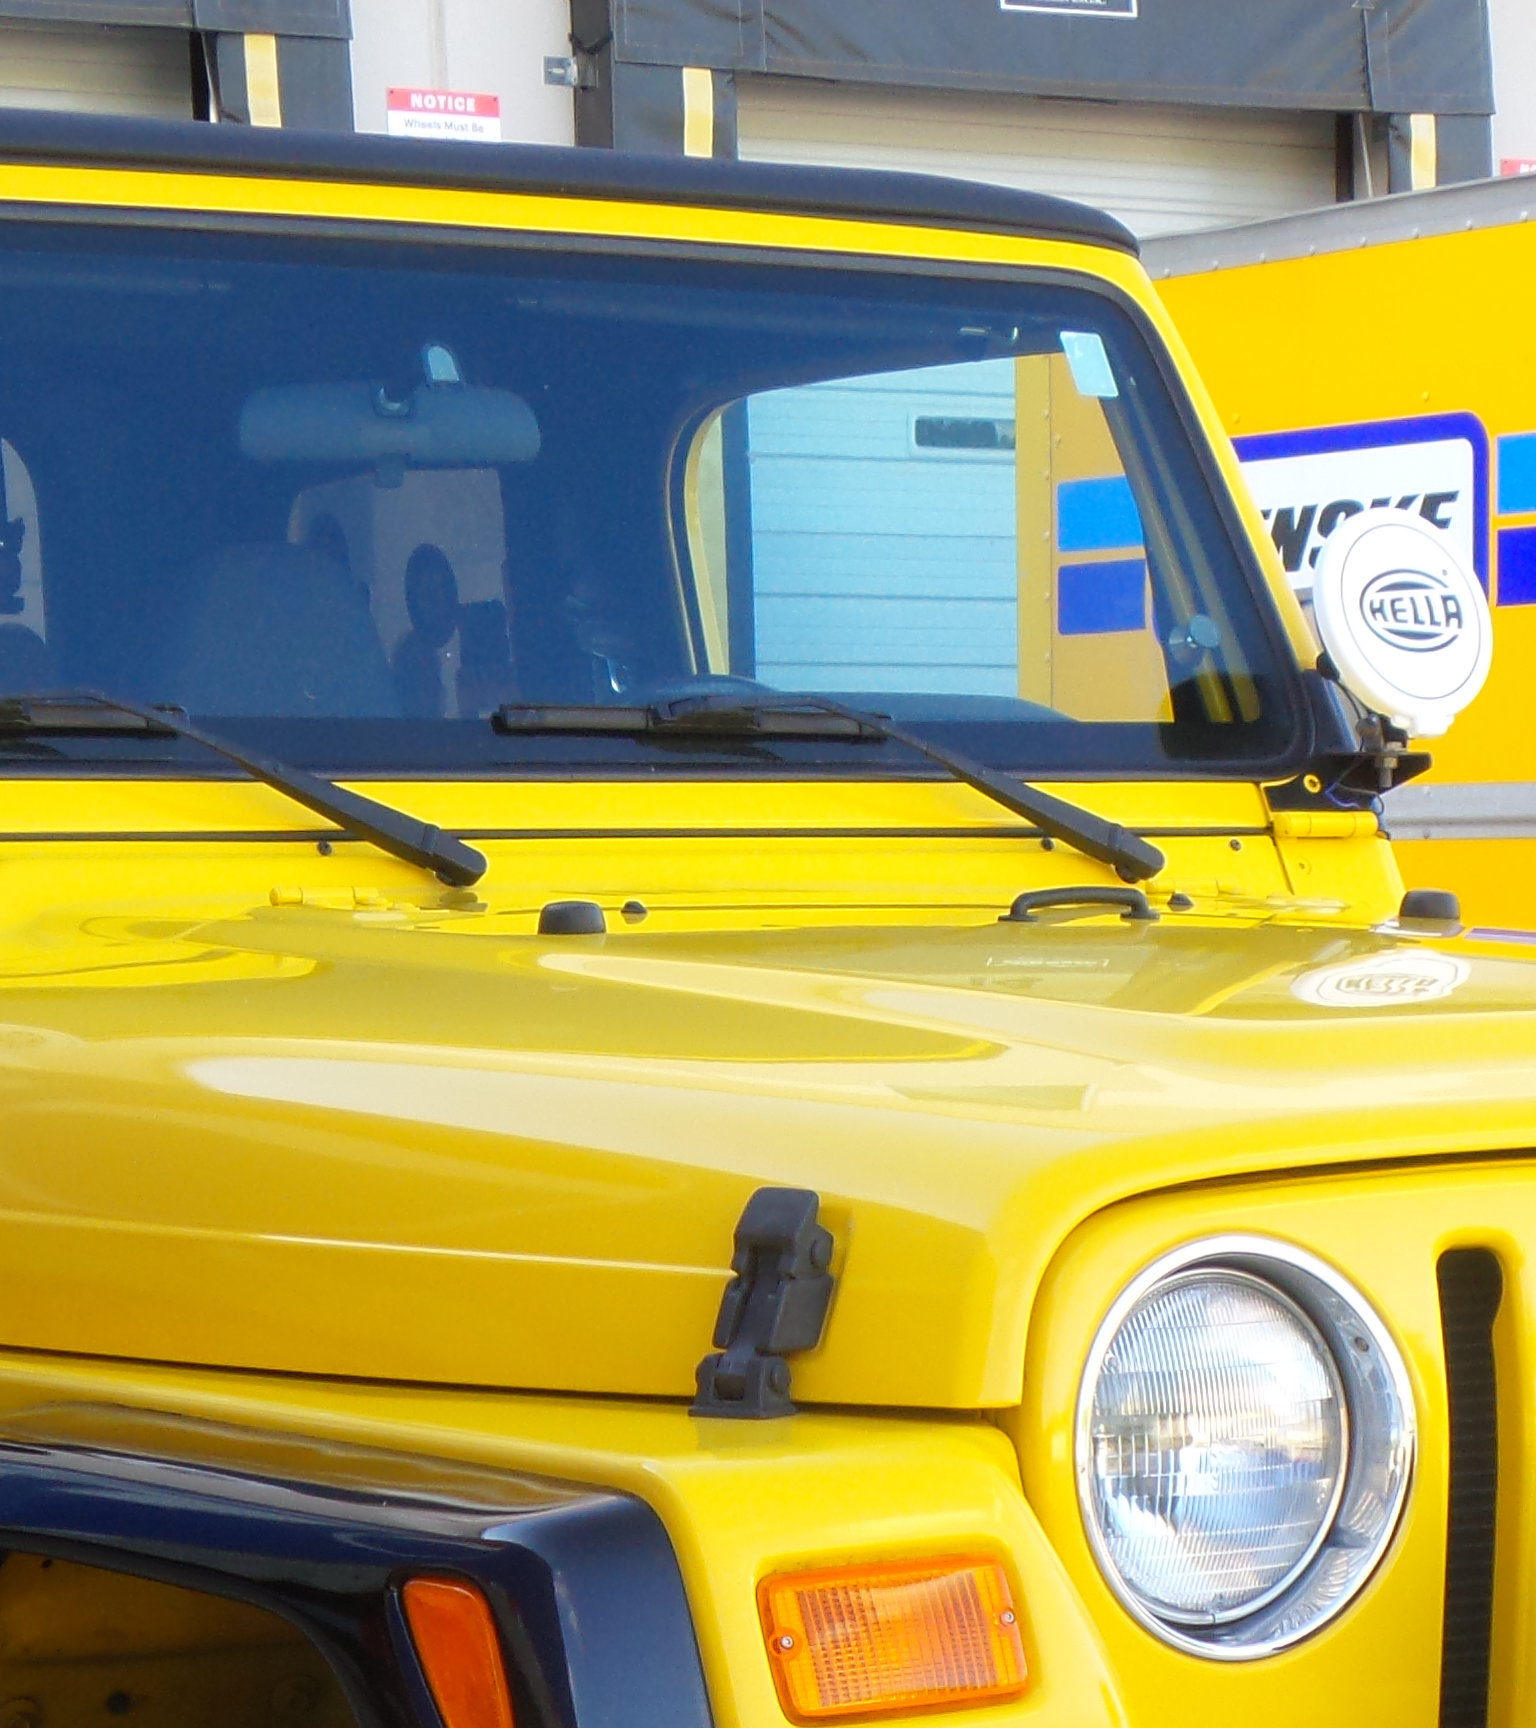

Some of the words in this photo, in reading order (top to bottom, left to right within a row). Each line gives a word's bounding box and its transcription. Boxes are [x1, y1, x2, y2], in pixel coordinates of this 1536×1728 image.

[410, 93, 475, 112] NOTICE
[405, 118, 441, 130] Wheels
[445, 121, 468, 132] Must
[472, 123, 484, 133] Be
[1369, 594, 1463, 629] HELLA
